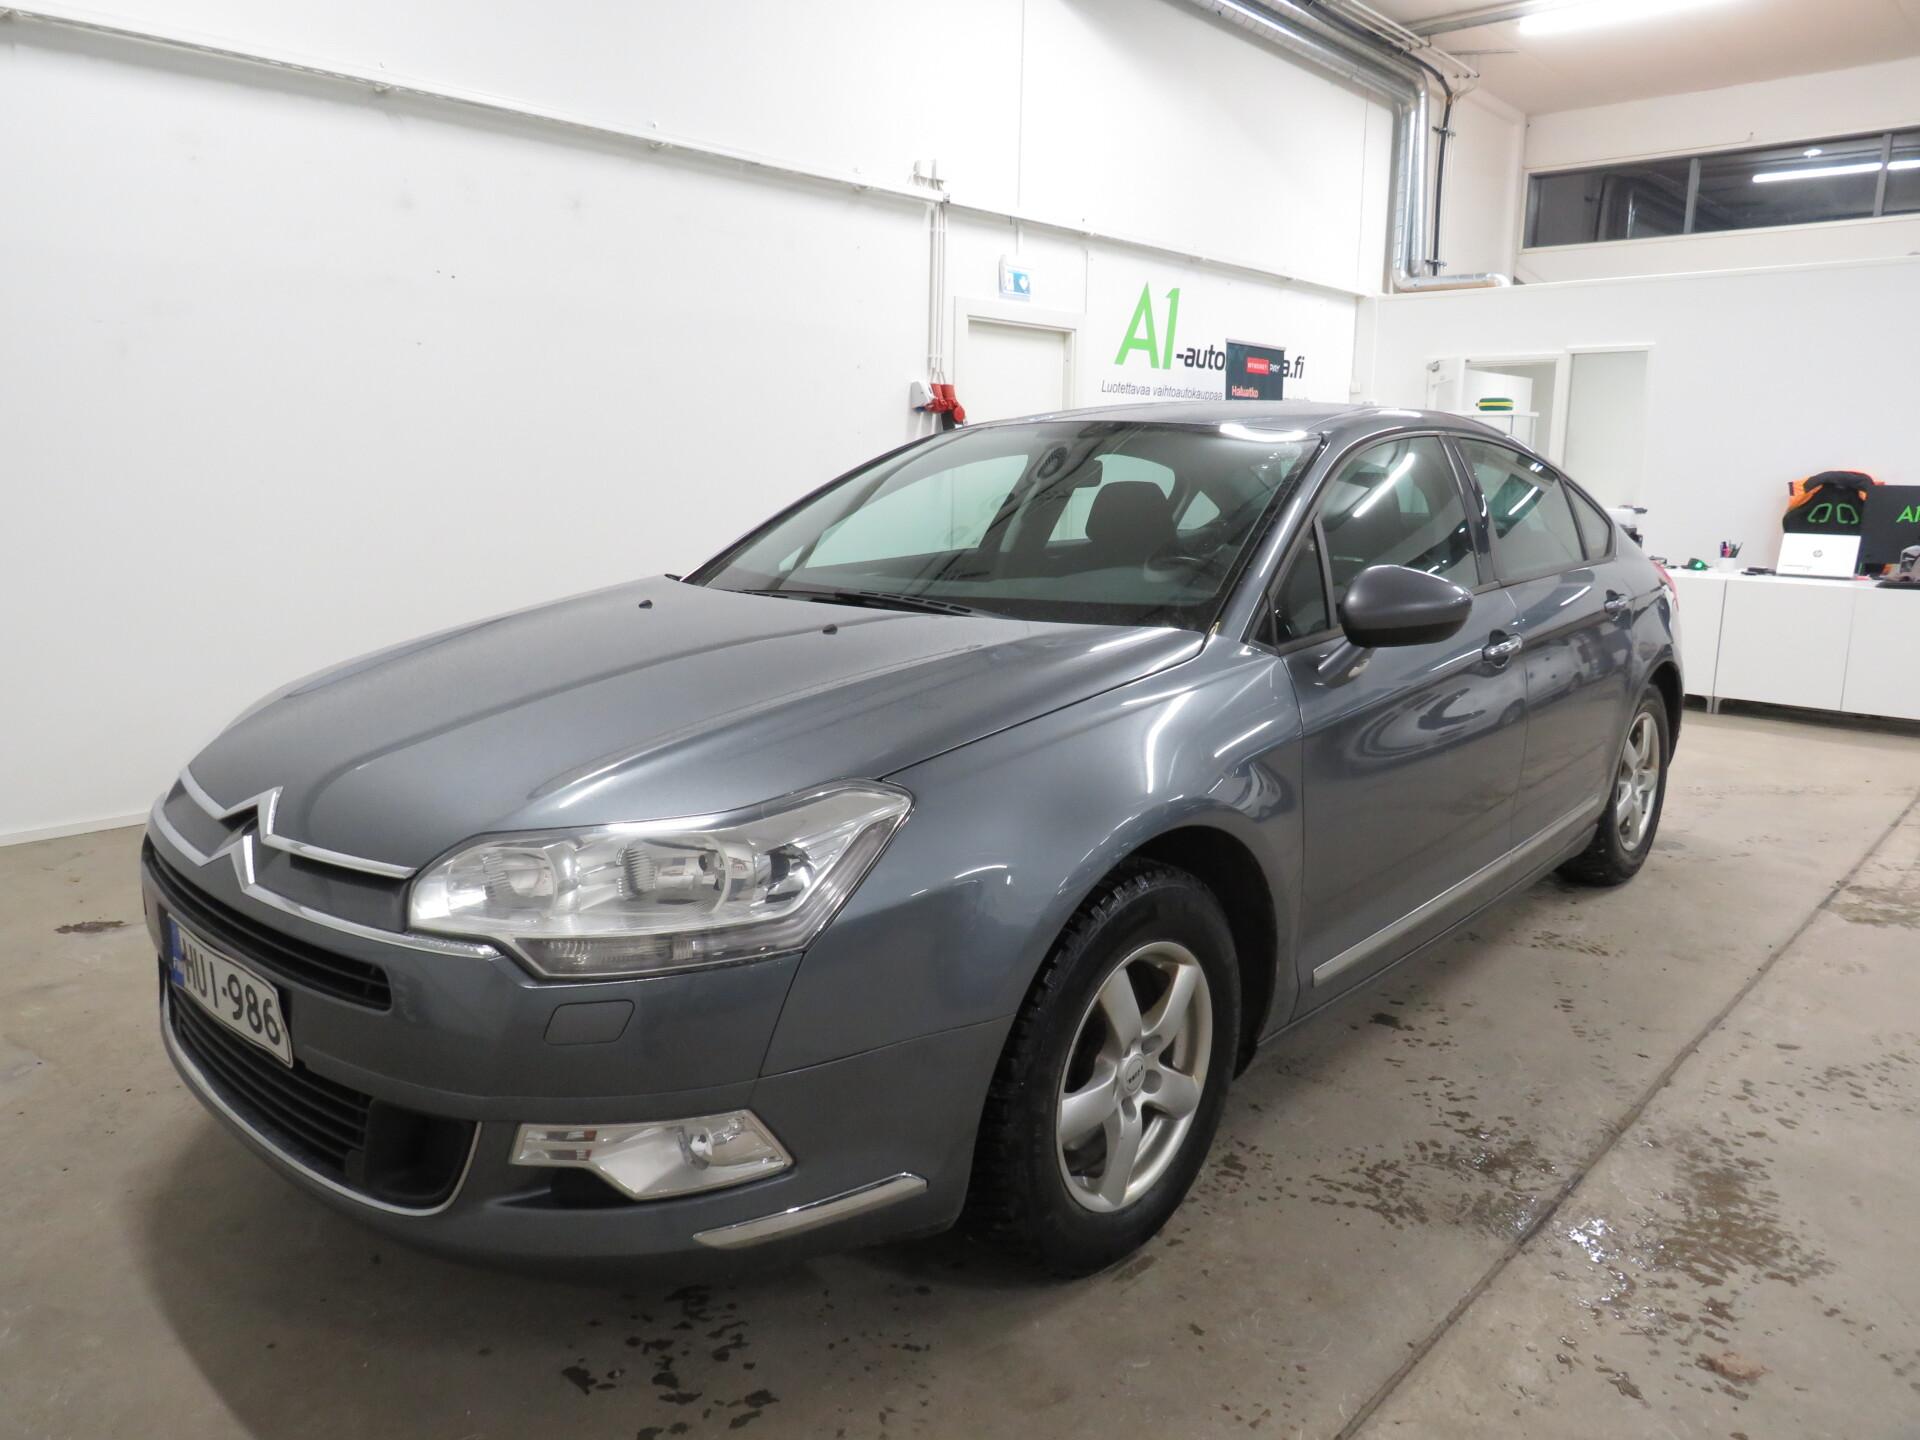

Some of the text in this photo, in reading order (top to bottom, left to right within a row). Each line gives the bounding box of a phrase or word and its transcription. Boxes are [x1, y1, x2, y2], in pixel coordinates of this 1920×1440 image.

[1101, 379, 1223, 401] Luotettavaa vaihtoautokauppaa
[182, 938, 281, 1046] HUI-986
